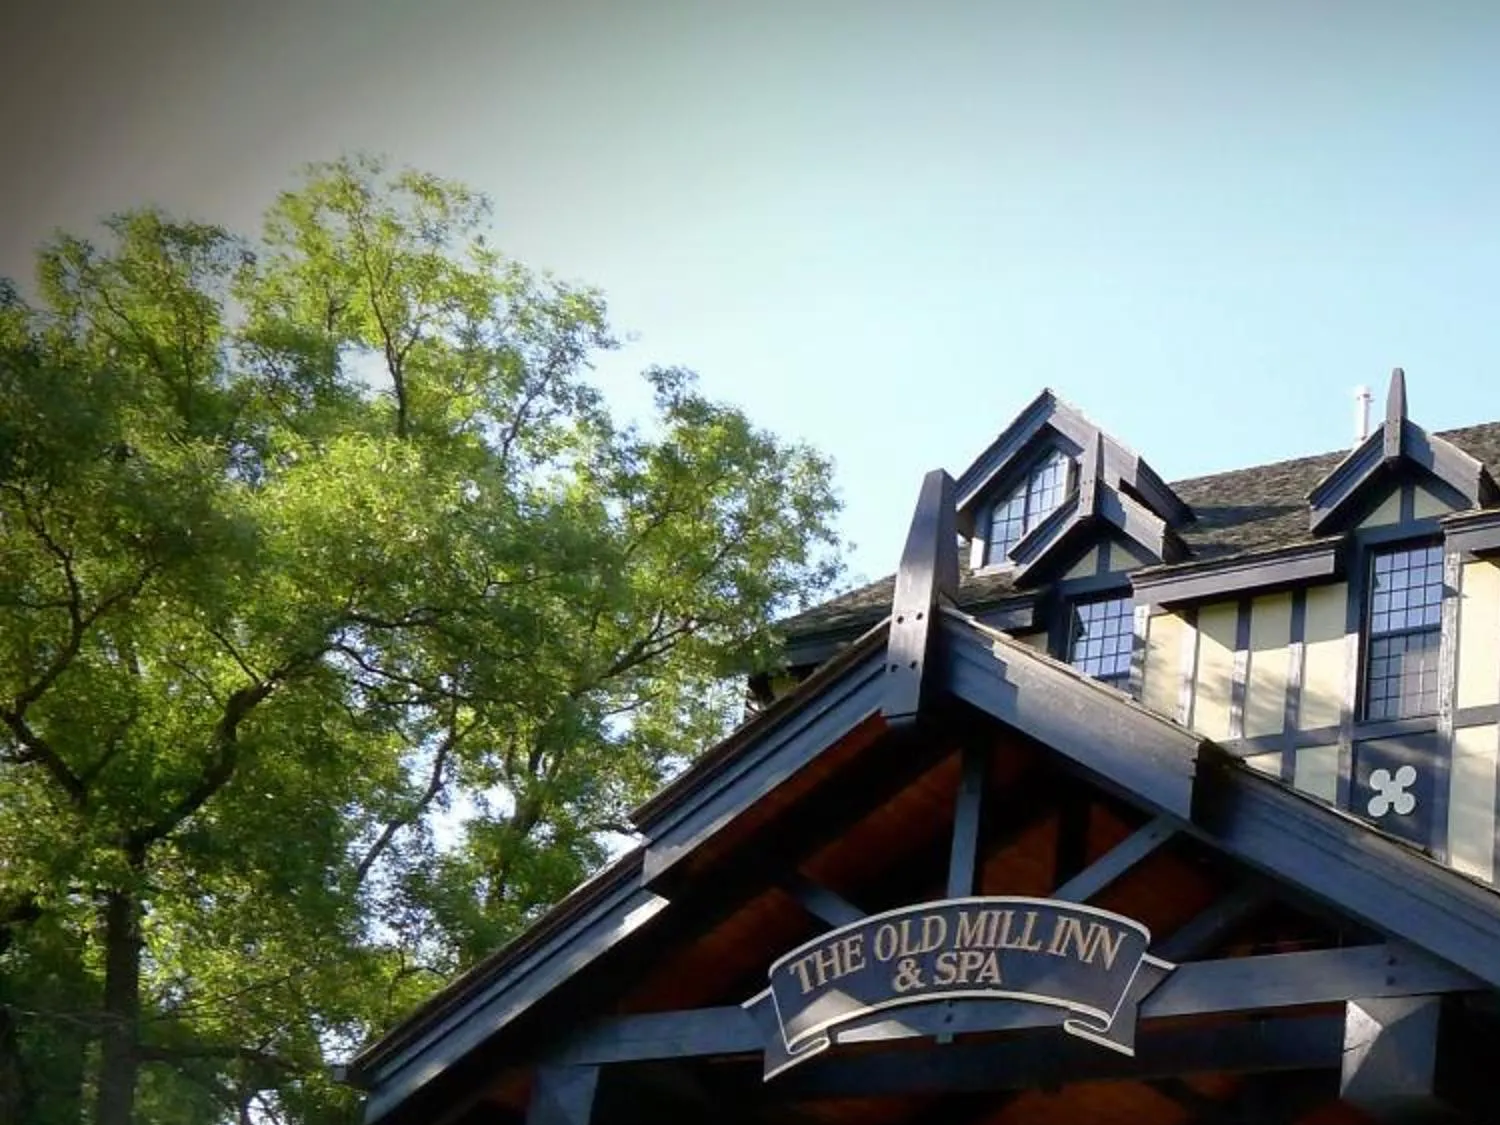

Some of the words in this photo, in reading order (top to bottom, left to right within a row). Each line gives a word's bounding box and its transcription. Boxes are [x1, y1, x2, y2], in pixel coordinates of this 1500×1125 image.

[788, 933, 865, 994] THE
[873, 914, 948, 961] OLD
[953, 910, 1043, 952] MILL
[1050, 915, 1129, 971] INN
[892, 958, 923, 992] &
[934, 948, 1002, 988] SPA
